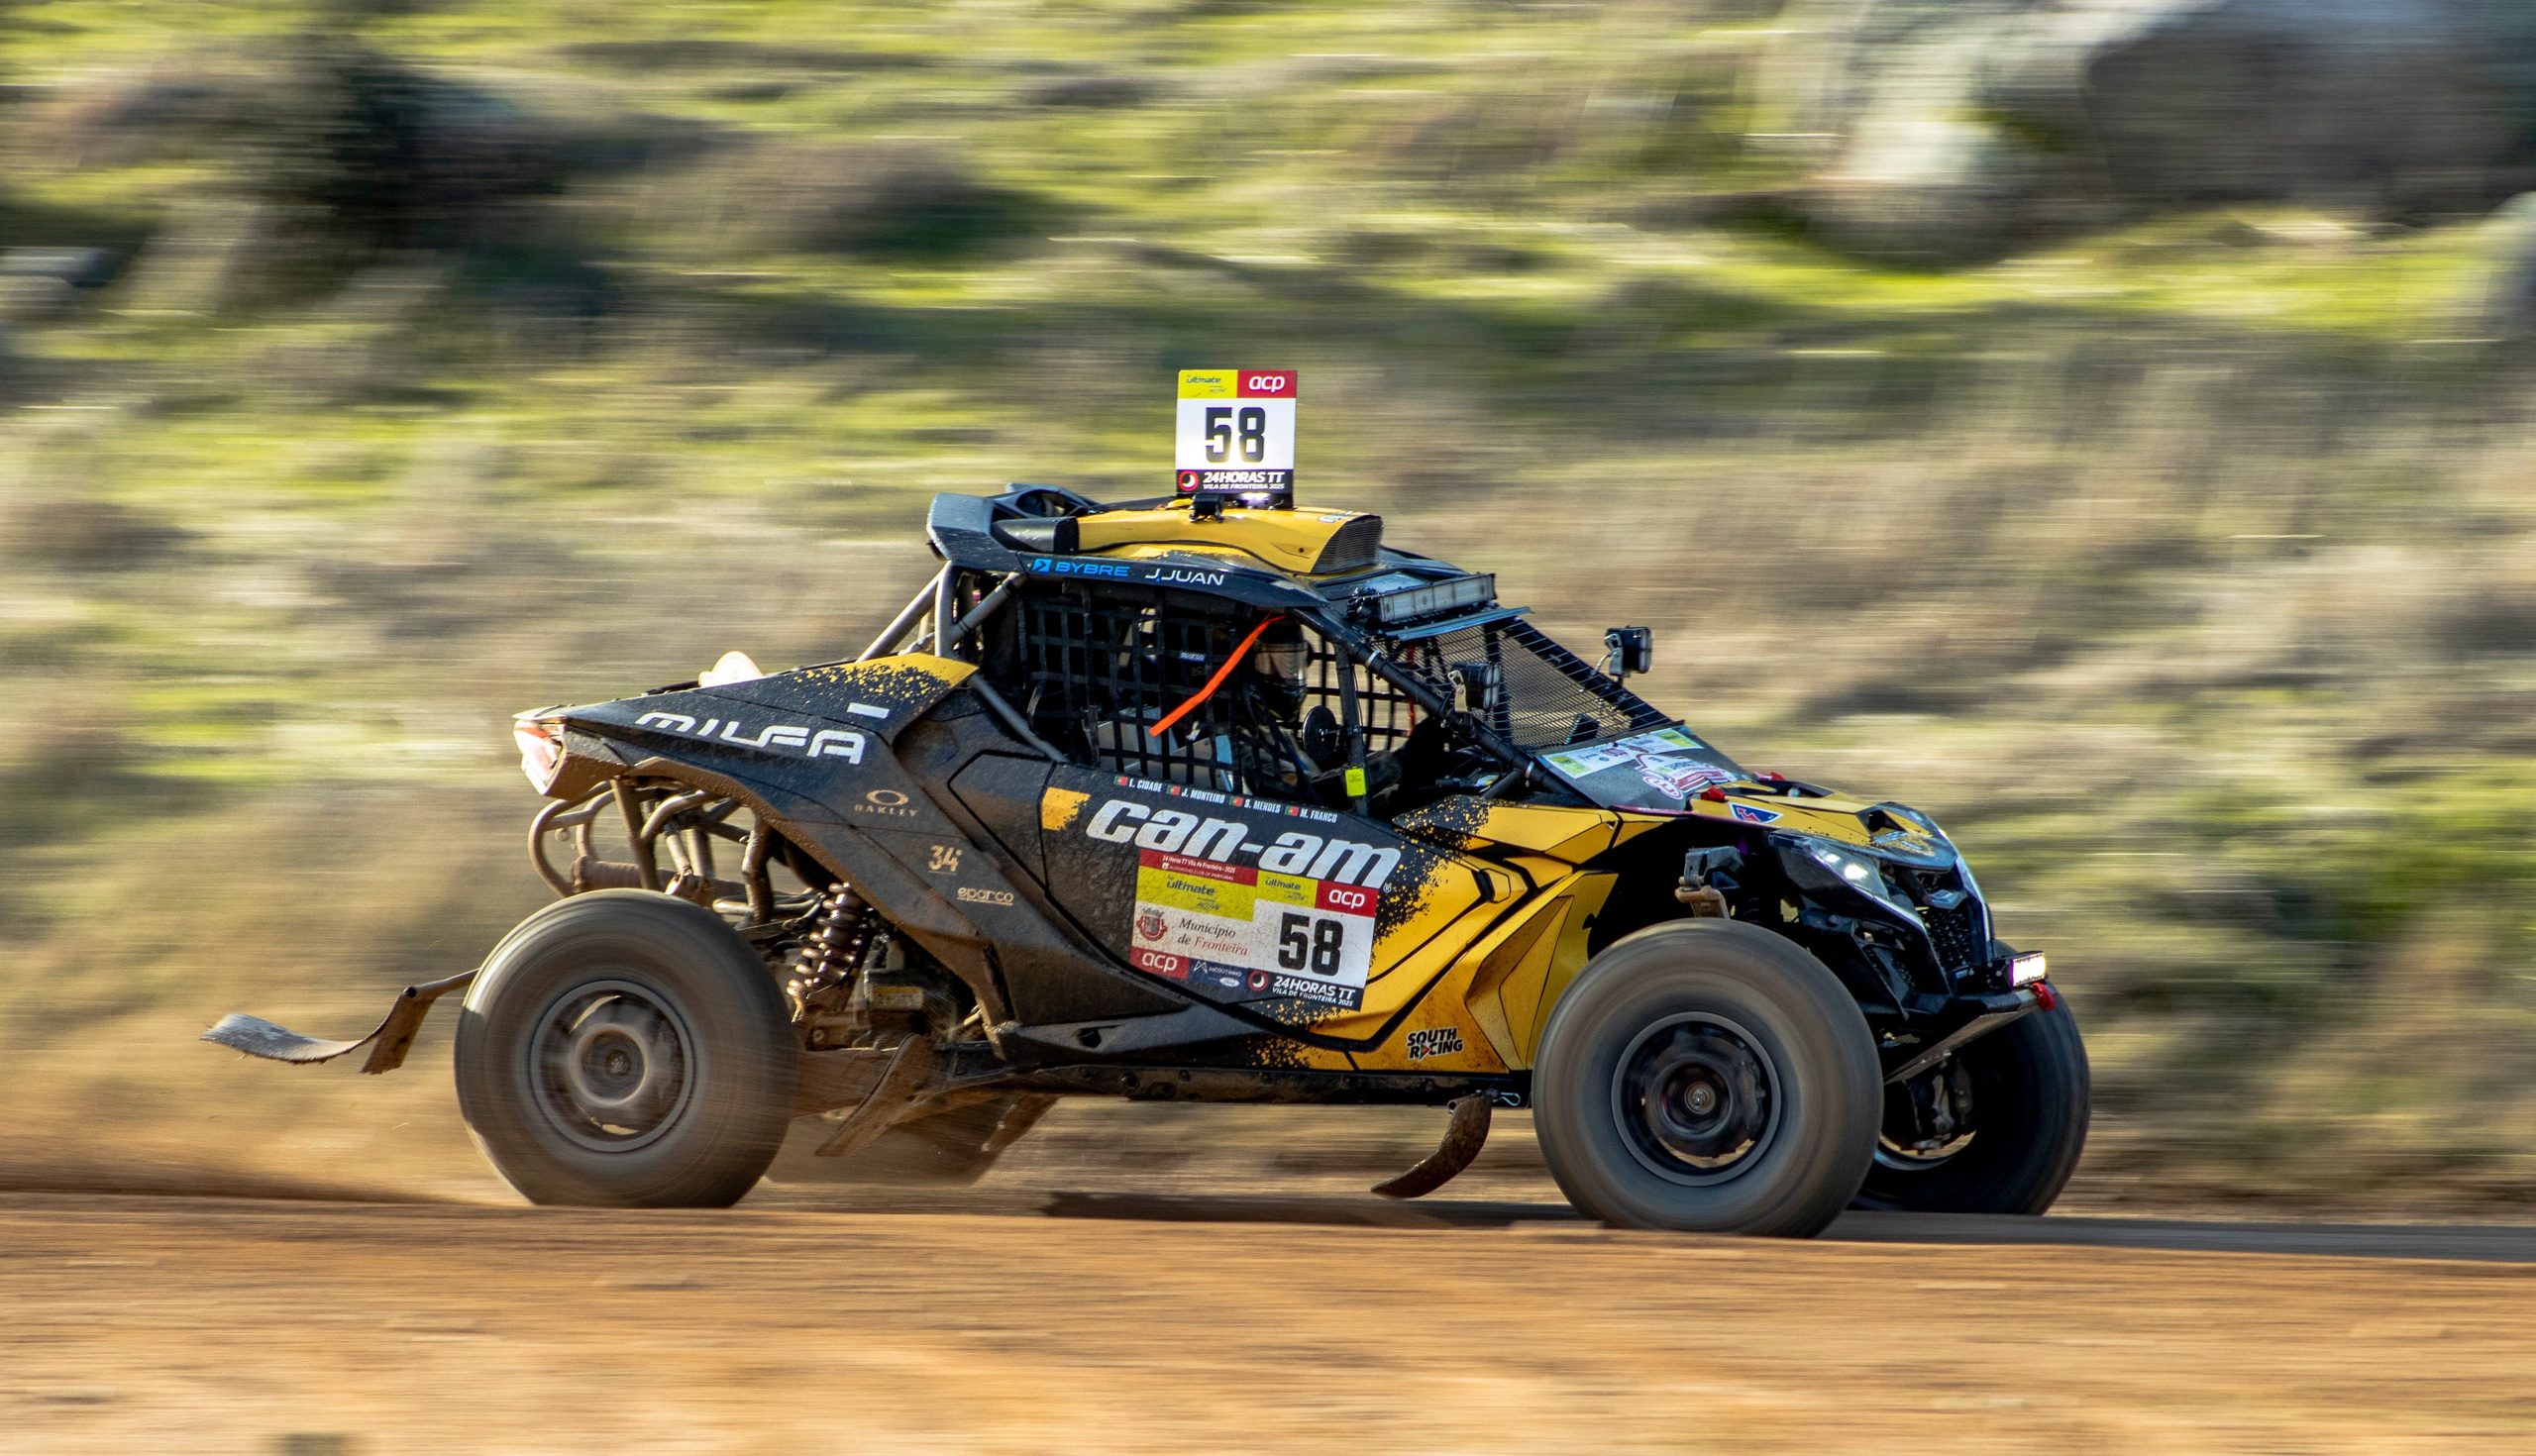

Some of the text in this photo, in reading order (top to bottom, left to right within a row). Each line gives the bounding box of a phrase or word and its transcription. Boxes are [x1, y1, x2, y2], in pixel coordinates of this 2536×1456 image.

[1248, 375, 1285, 392] acp
[1206, 407, 1266, 464] 58
[1267, 471, 1285, 483] TT
[1055, 562, 1130, 577] BYBRE
[1145, 569, 1225, 586] J.JUAN
[634, 712, 866, 765] MILFA
[1137, 780, 1163, 792] CIDADE
[1182, 786, 1226, 804] J. MONTEIRO
[854, 803, 918, 817] OAKLEY
[1244, 798, 1281, 813] S. MENDES
[1300, 808, 1338, 824] M. FRANCO
[1086, 799, 1402, 889] can-am
[1203, 862, 1222, 872] Fronteira
[1167, 881, 1215, 895] ultimate
[1265, 879, 1301, 890] ultimate
[957, 886, 1014, 905] sparco
[1328, 889, 1365, 909] acp
[1179, 918, 1236, 938] Município
[1178, 934, 1248, 957] de Fronteira
[1277, 912, 1344, 978] 58
[1141, 953, 1178, 972] acp
[1272, 987, 1288, 996] VILA
[1299, 992, 1337, 1004] FRONTEIRA
[1338, 988, 1356, 1000] TT
[1407, 1028, 1458, 1046] SOUTH
